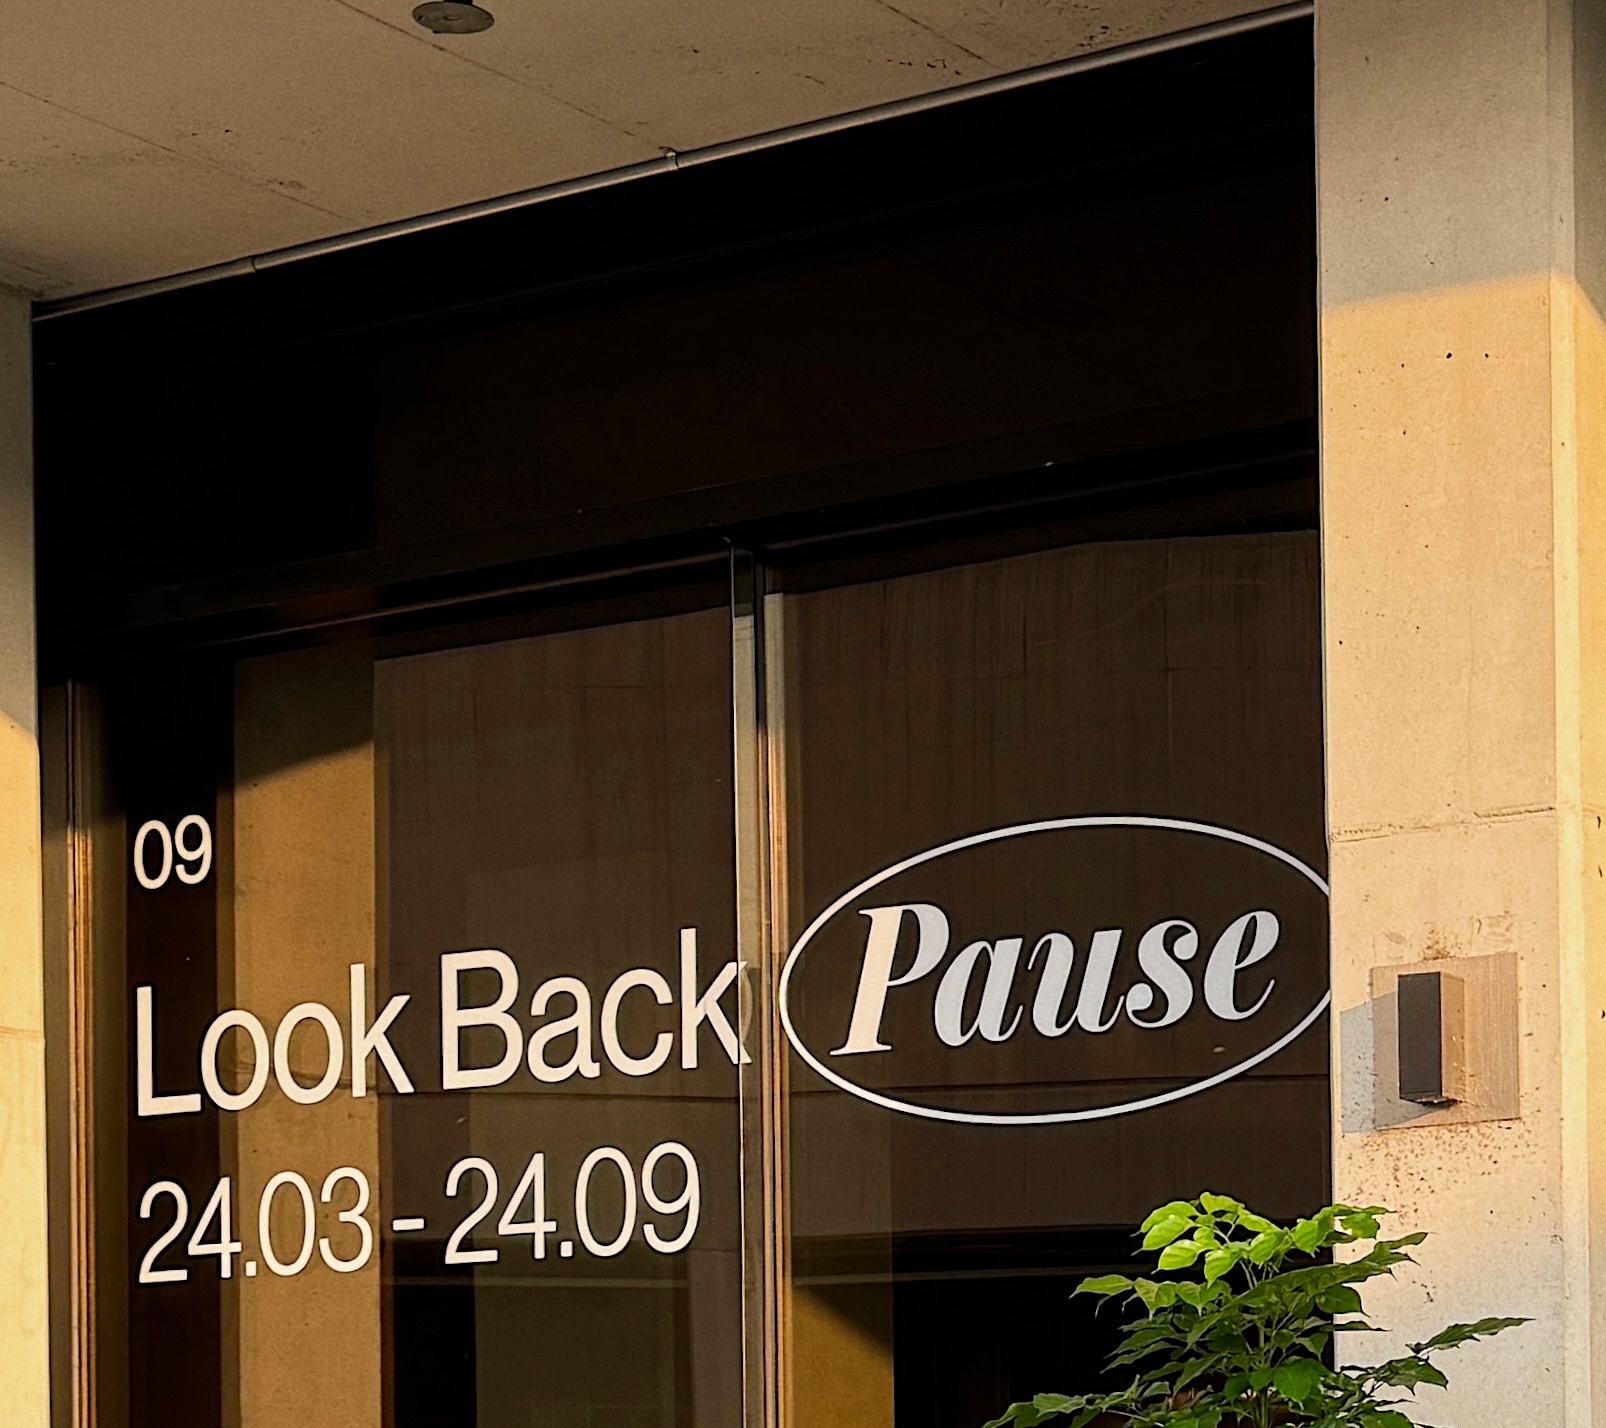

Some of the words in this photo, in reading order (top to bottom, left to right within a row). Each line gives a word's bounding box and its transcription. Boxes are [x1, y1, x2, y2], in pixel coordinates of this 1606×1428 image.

[133, 814, 213, 889] 09
[137, 963, 415, 1117] Look
[441, 927, 752, 1092] Back
[829, 901, 1282, 1056] Pause
[139, 1166, 373, 1285] 24.03
[445, 1142, 701, 1266] 24.09
